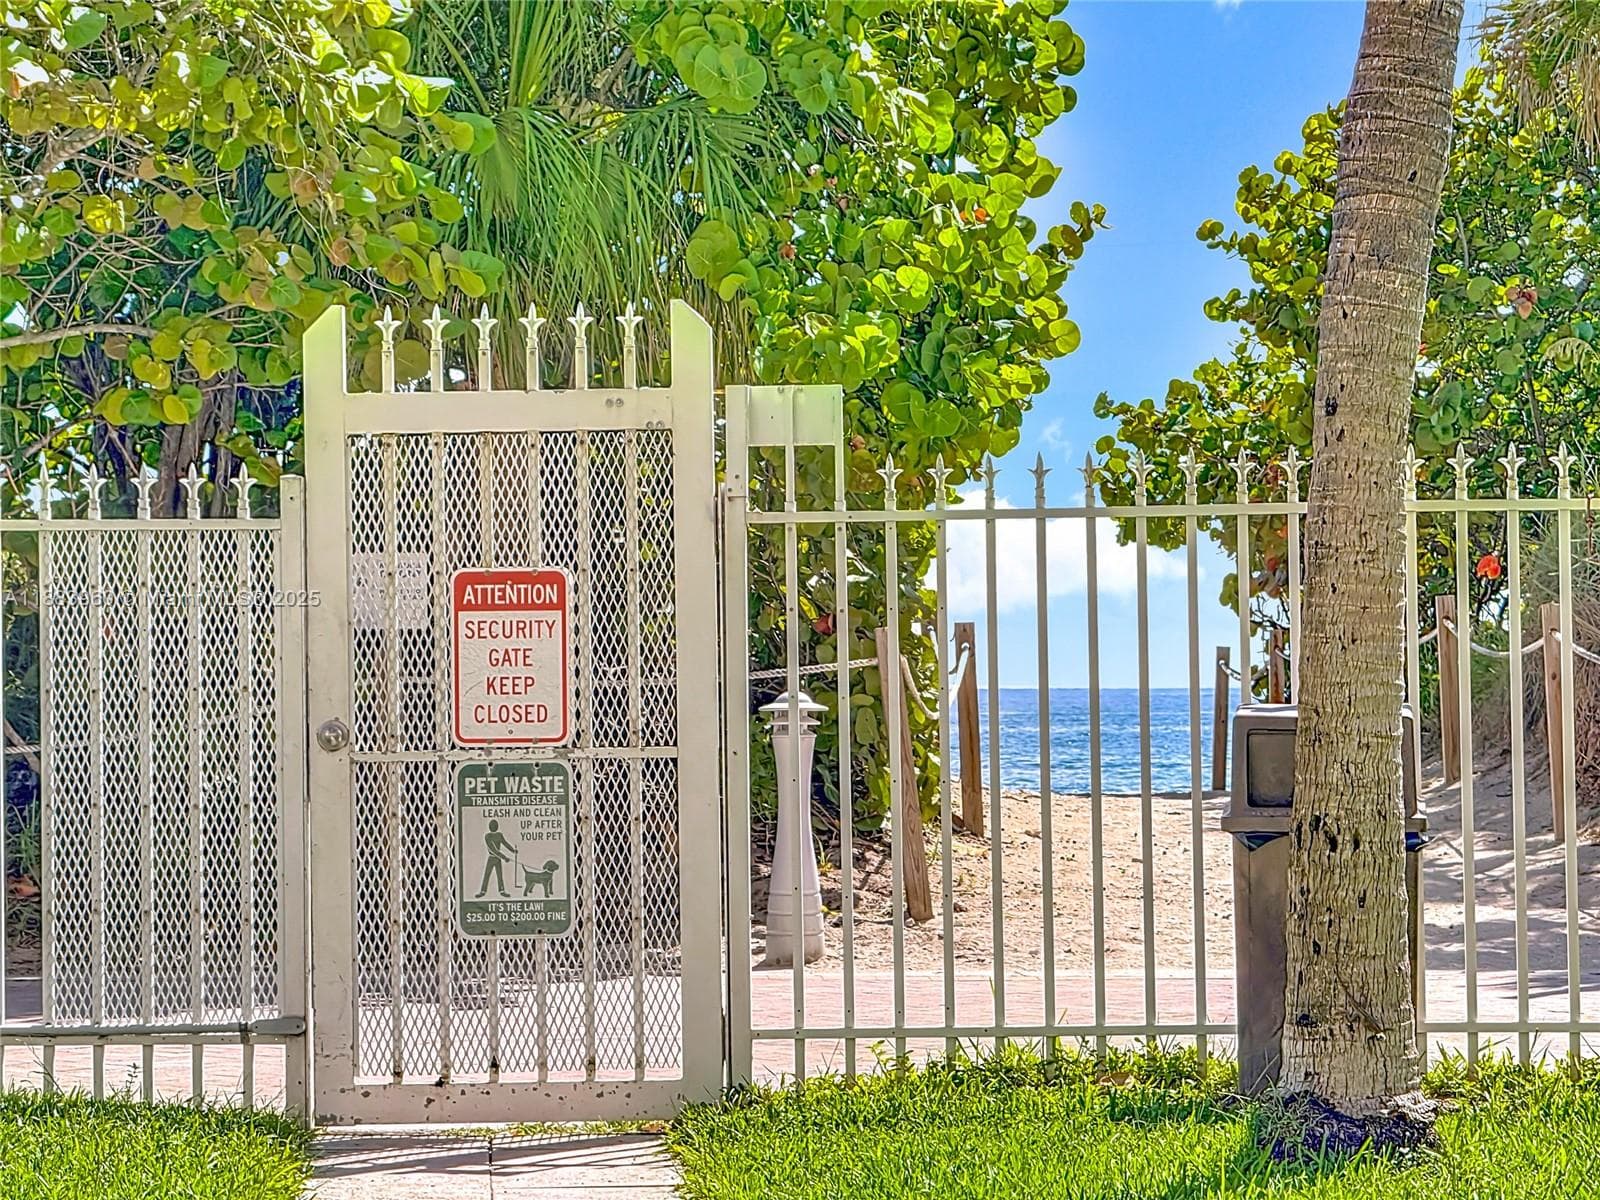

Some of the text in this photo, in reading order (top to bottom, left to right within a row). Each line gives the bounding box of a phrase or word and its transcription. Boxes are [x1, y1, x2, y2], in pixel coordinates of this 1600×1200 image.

[463, 583, 558, 605] ATTENTION
[464, 619, 556, 639] SECURITY
[488, 648, 534, 668] GATE
[486, 676, 535, 696] KEEP
[474, 704, 548, 724] CLOSED
[464, 775, 565, 794] PET WASTE
[471, 795, 558, 806] TRANSMITS DISEASE
[482, 807, 562, 818] LEASH AND CLEAN
[520, 819, 562, 830] UP AFTER
[520, 831, 562, 841] YOUR PET
[488, 902, 544, 912] IT'S THE LAW!
[466, 911, 567, 922] $25.00 TO $200.00 FINE
